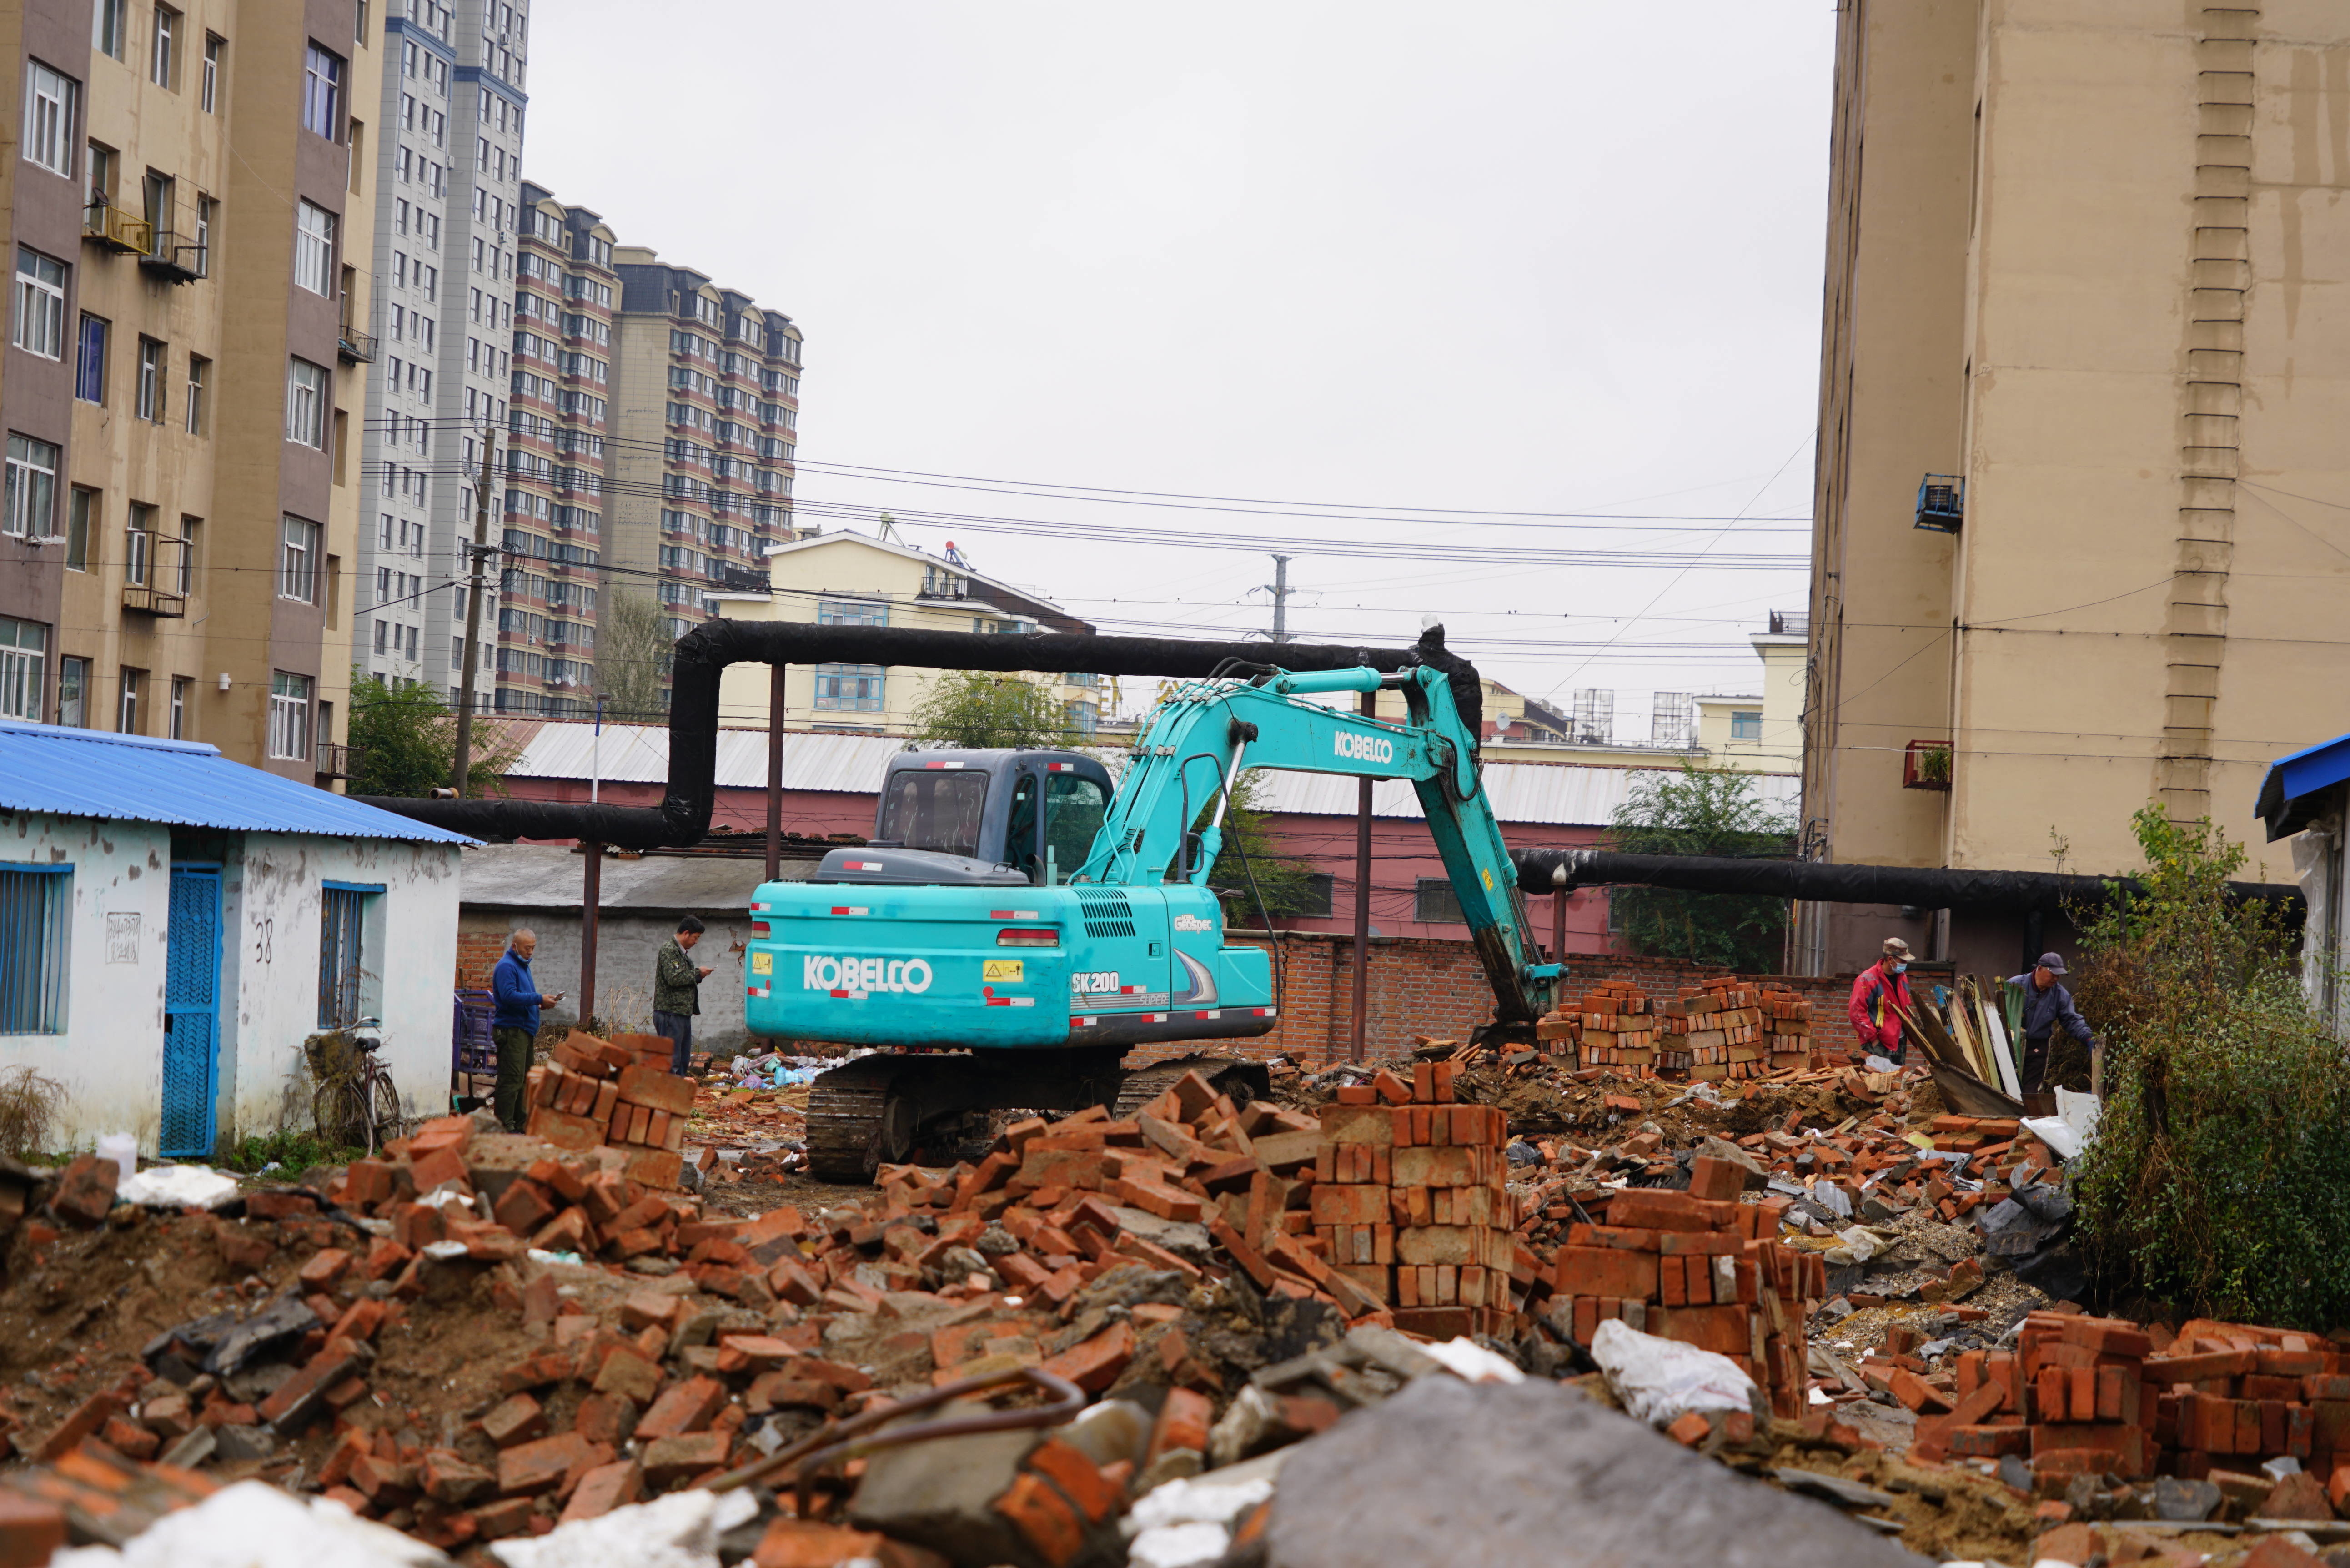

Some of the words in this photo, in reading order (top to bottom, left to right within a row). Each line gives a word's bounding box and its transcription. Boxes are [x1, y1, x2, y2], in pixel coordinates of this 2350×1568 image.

[1335, 731, 1392, 764] KOBELCO
[256, 918, 273, 964] 38
[804, 955, 932, 993] KOBELCO
[1071, 971, 1119, 993] SK200
[1139, 995, 1167, 1006] SUPER
